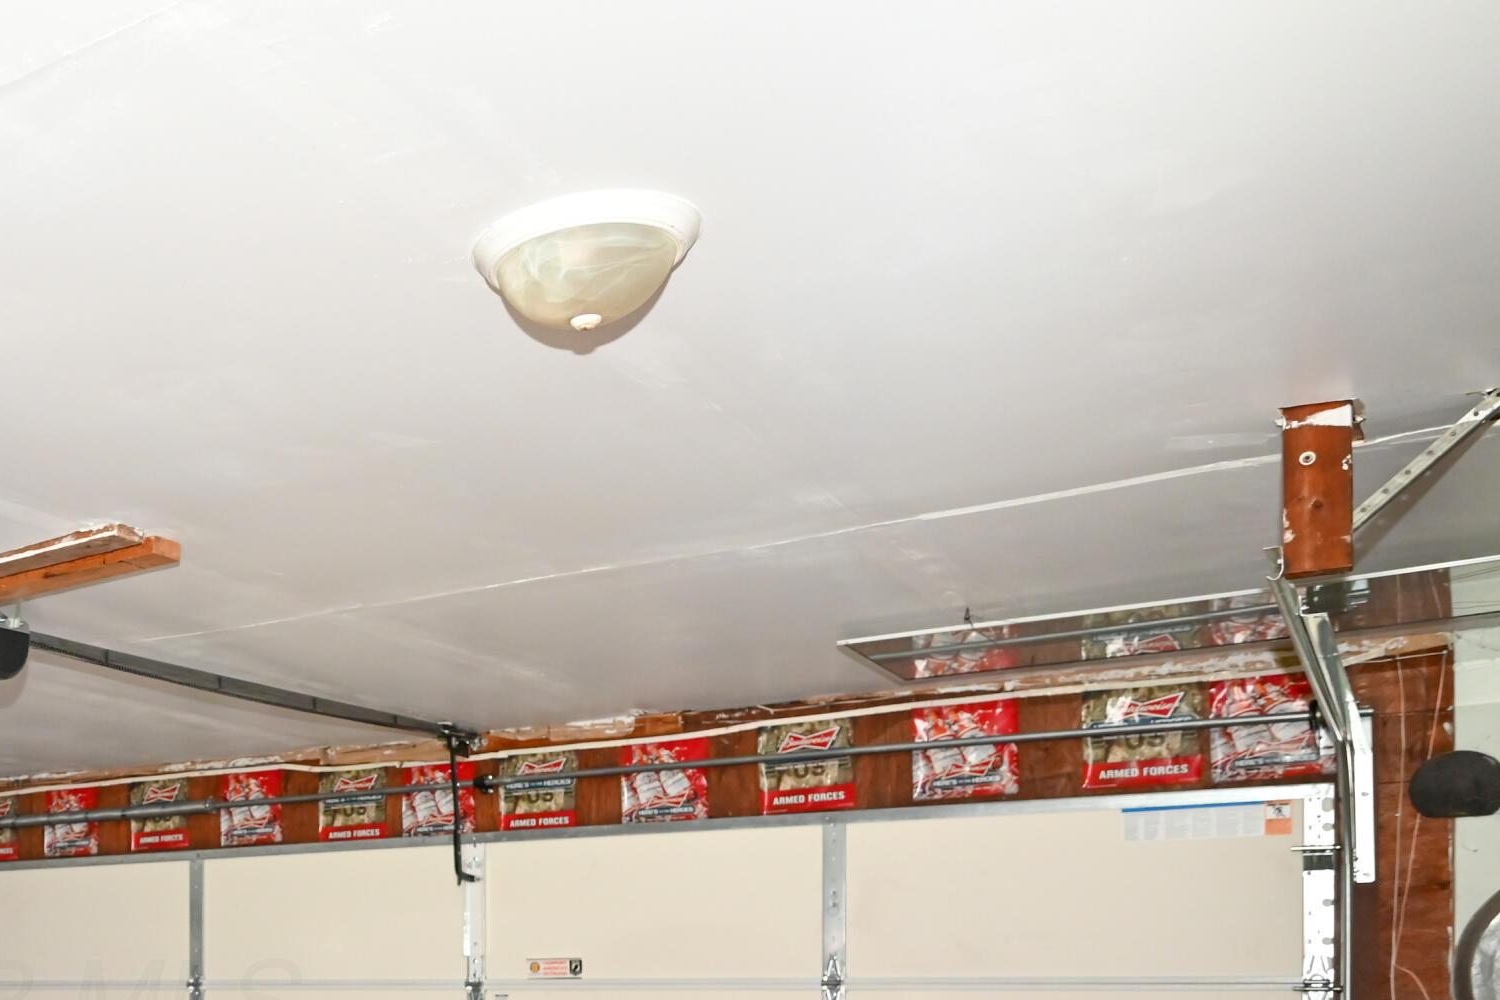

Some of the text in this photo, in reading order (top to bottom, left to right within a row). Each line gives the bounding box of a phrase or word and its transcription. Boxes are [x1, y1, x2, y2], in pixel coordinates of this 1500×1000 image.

[1099, 764, 1189, 779] ARMED FORCES
[772, 791, 845, 805] ARMED FORCES
[510, 816, 569, 828] ARMED FORCES
[328, 828, 380, 839] ARMED FORCES
